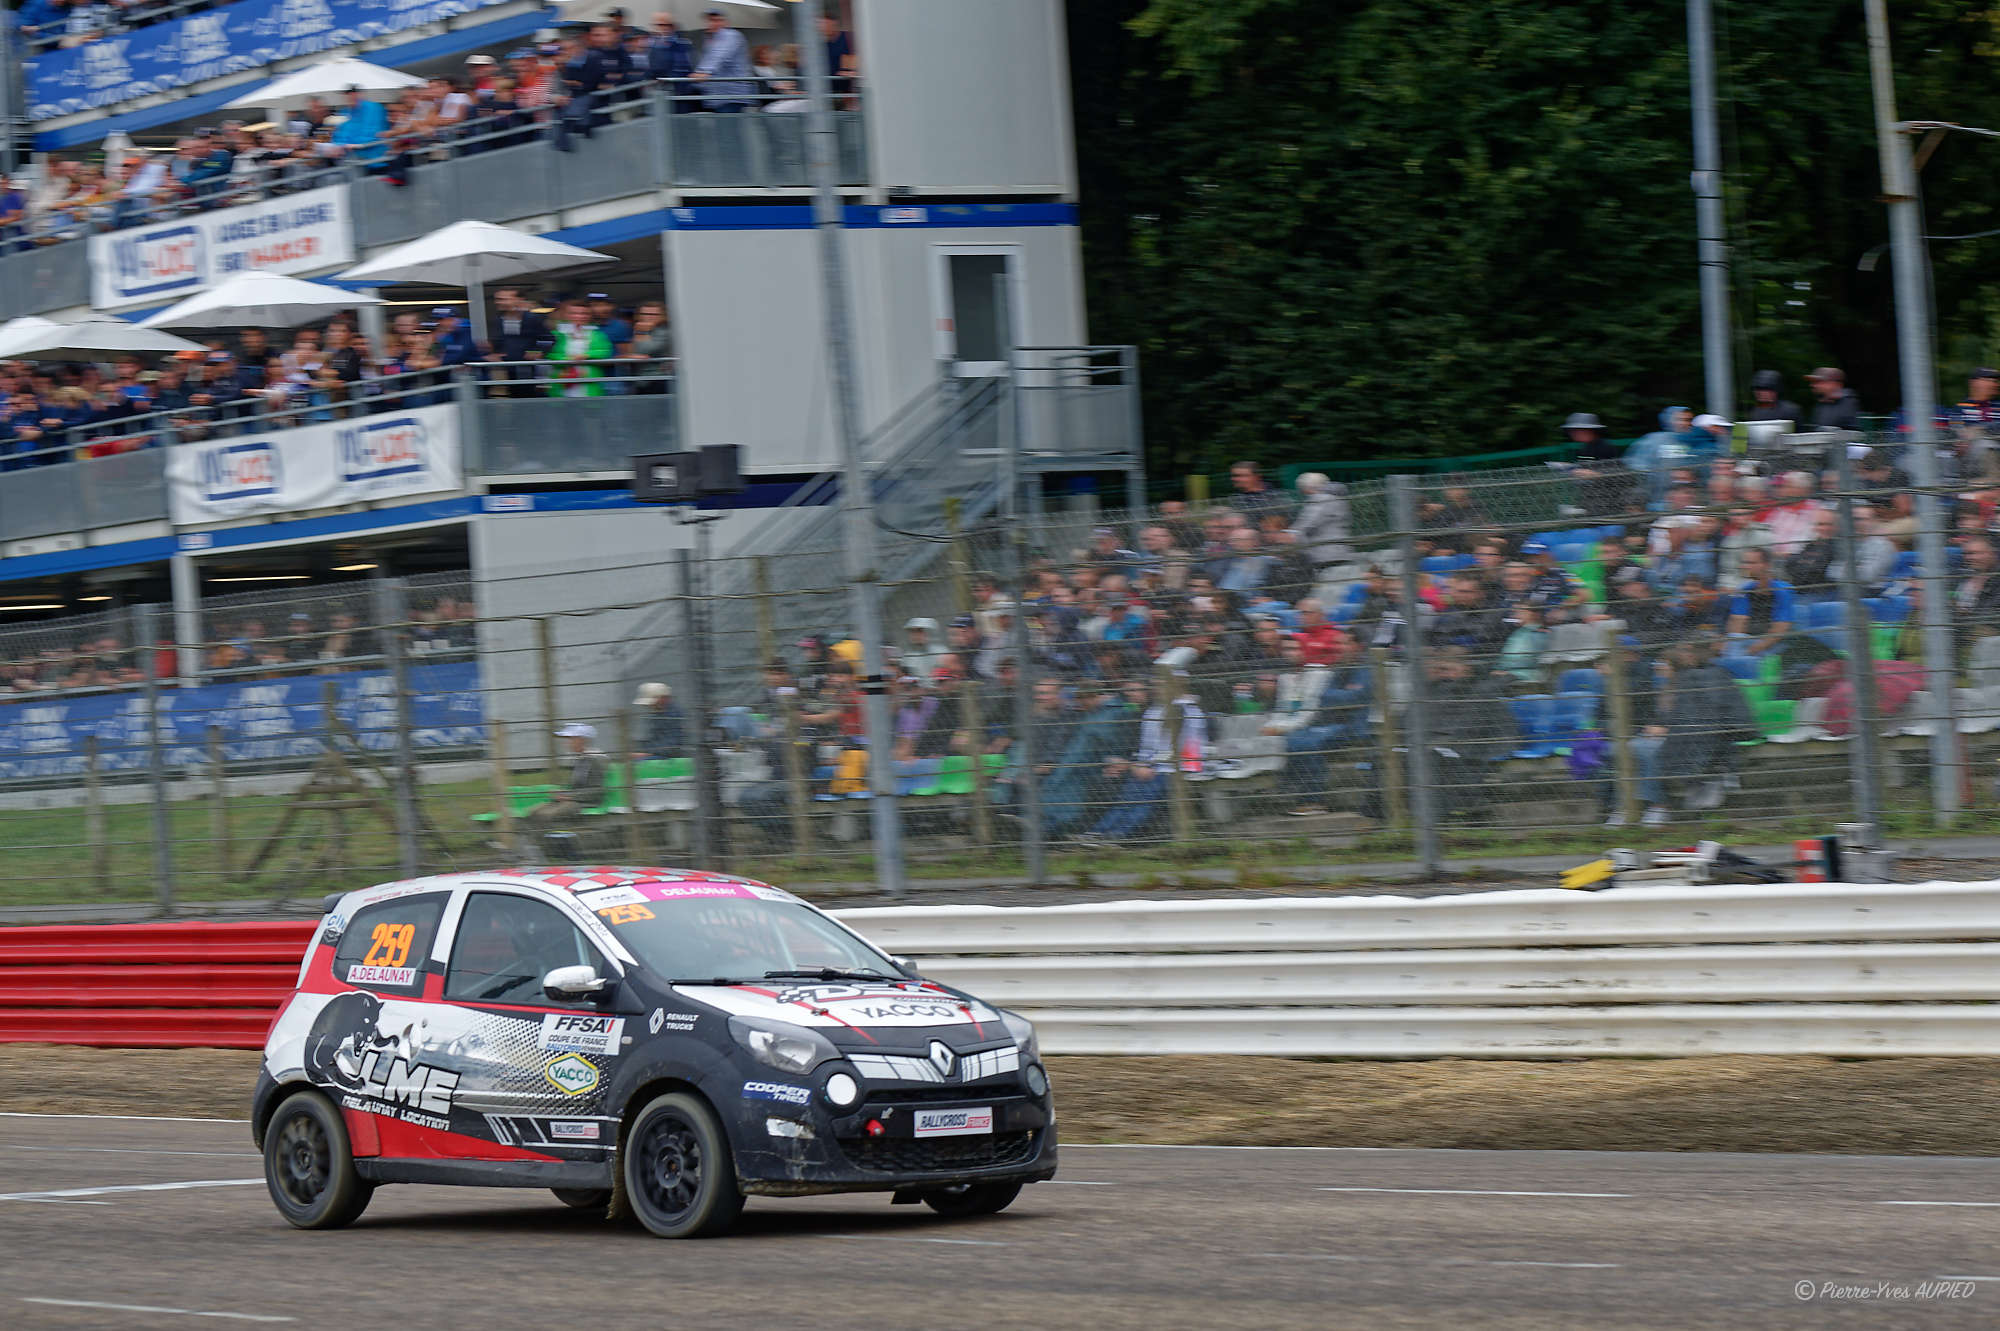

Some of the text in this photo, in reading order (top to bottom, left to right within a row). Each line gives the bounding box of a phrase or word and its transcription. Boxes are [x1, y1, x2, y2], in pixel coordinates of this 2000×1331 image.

[598, 903, 656, 926] 259
[363, 922, 416, 968] 259
[349, 967, 413, 983] A.DELAUNAY
[666, 1013, 699, 1022] RENAULT
[850, 1004, 955, 1018] YACCO
[554, 1016, 606, 1033] FFSA
[666, 1022, 695, 1031] TRUCKS
[547, 1034, 609, 1046] COUPE DE FRANCE
[553, 1066, 593, 1083] YACCO
[743, 1081, 811, 1098] COOPER
[772, 1092, 808, 1104] TIRES
[920, 1113, 968, 1129] RALLYCROSS
